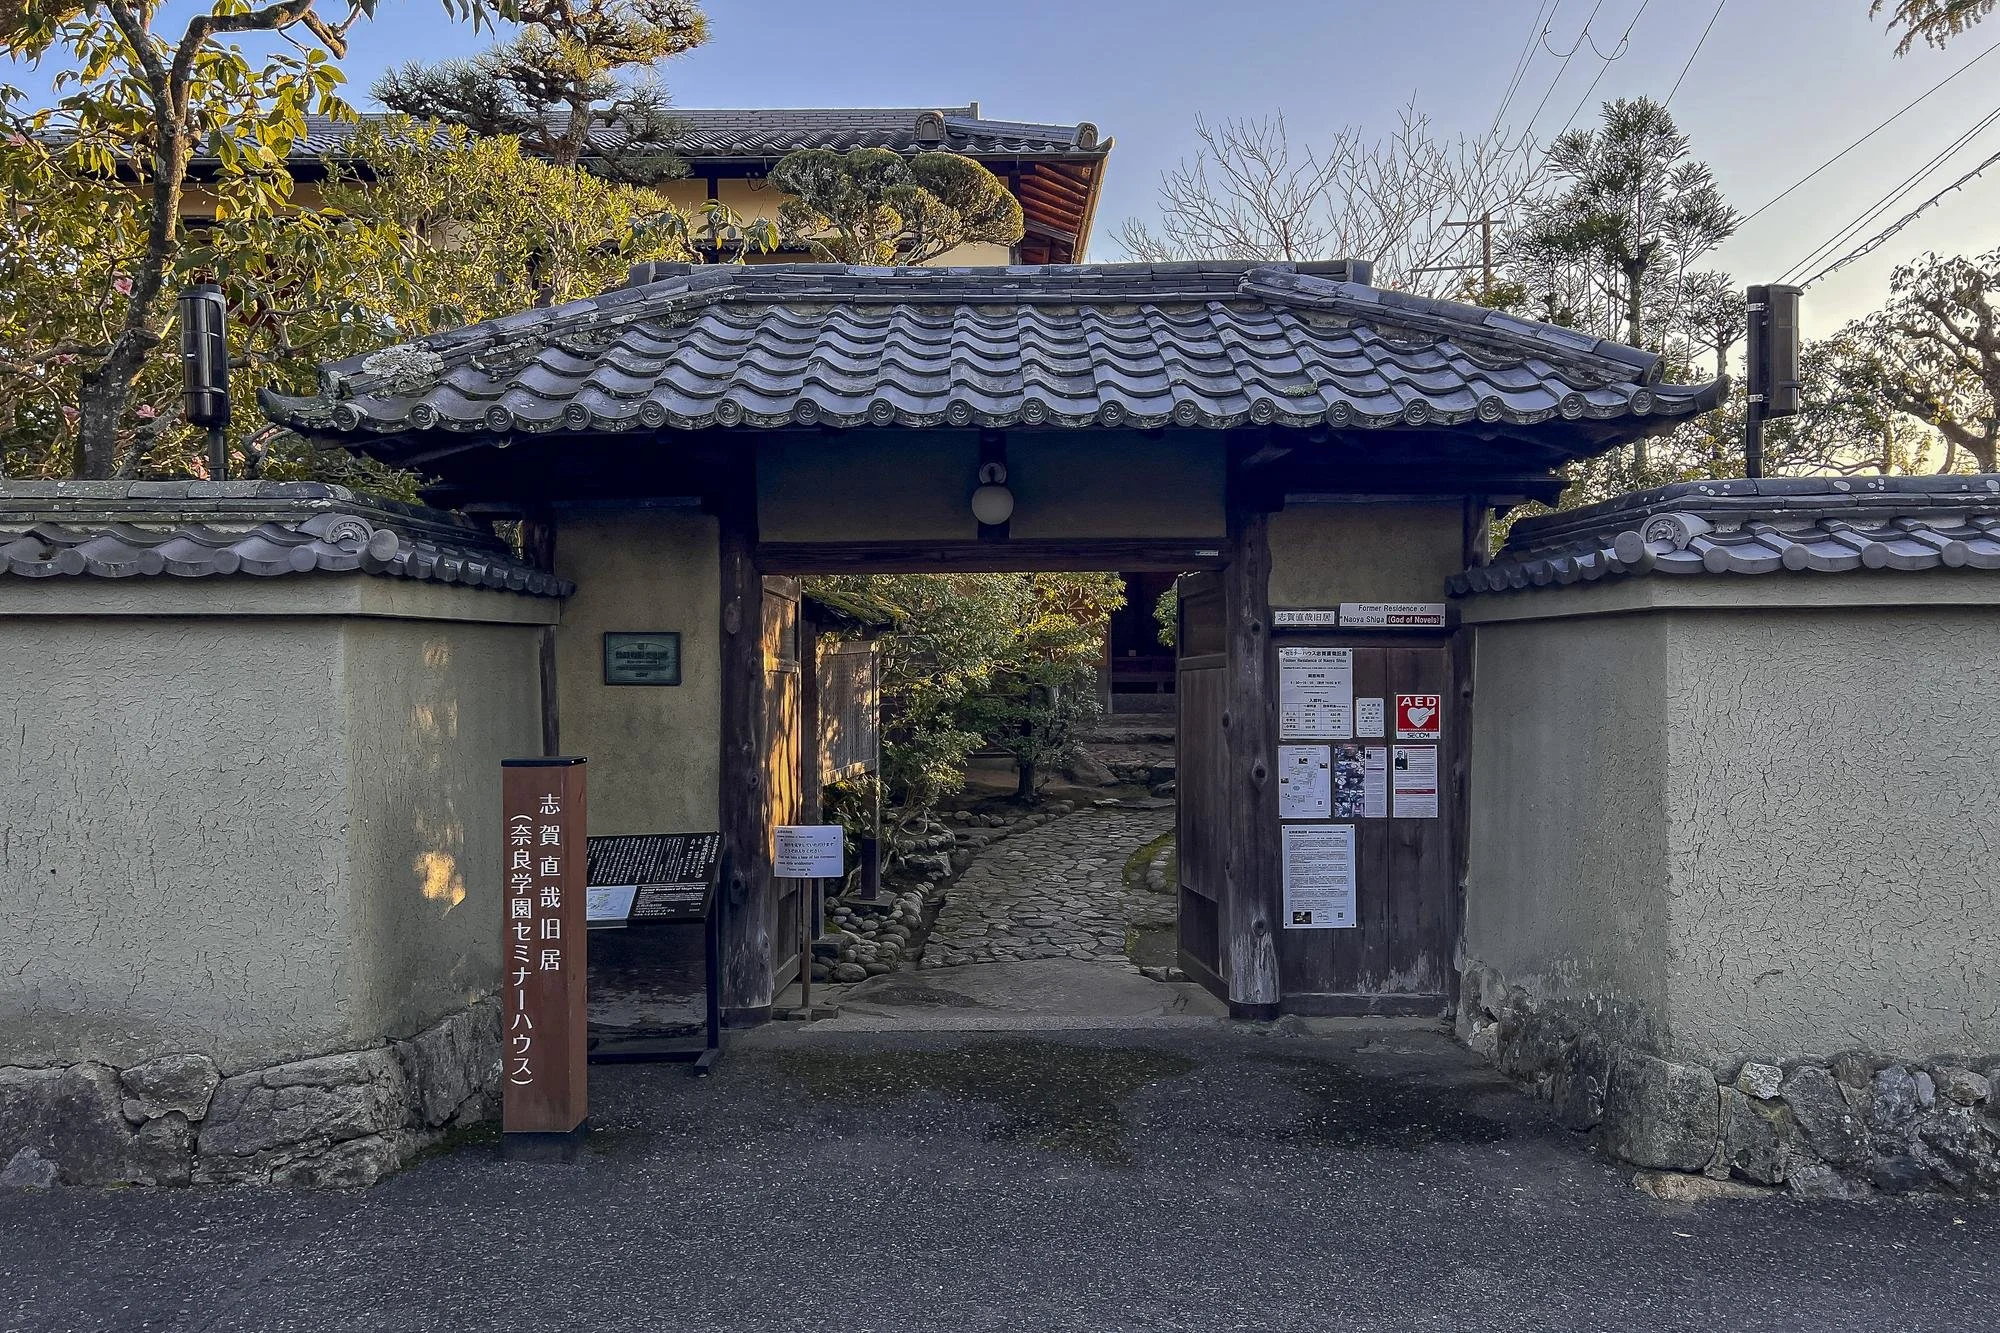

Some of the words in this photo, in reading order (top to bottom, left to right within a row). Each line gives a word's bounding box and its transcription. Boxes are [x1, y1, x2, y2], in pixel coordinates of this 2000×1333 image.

[1278, 612, 1331, 622] 志賀直哉旧居
[1343, 615, 1364, 624] Naoya
[1366, 615, 1385, 624] Shiga
[1387, 615, 1404, 624] (God
[1414, 615, 1440, 624] Novels)
[1400, 696, 1437, 707] AED
[539, 793, 561, 971] 志賀直哉旧居
[510, 814, 533, 1085] （奈良学園セミナーハウス）
